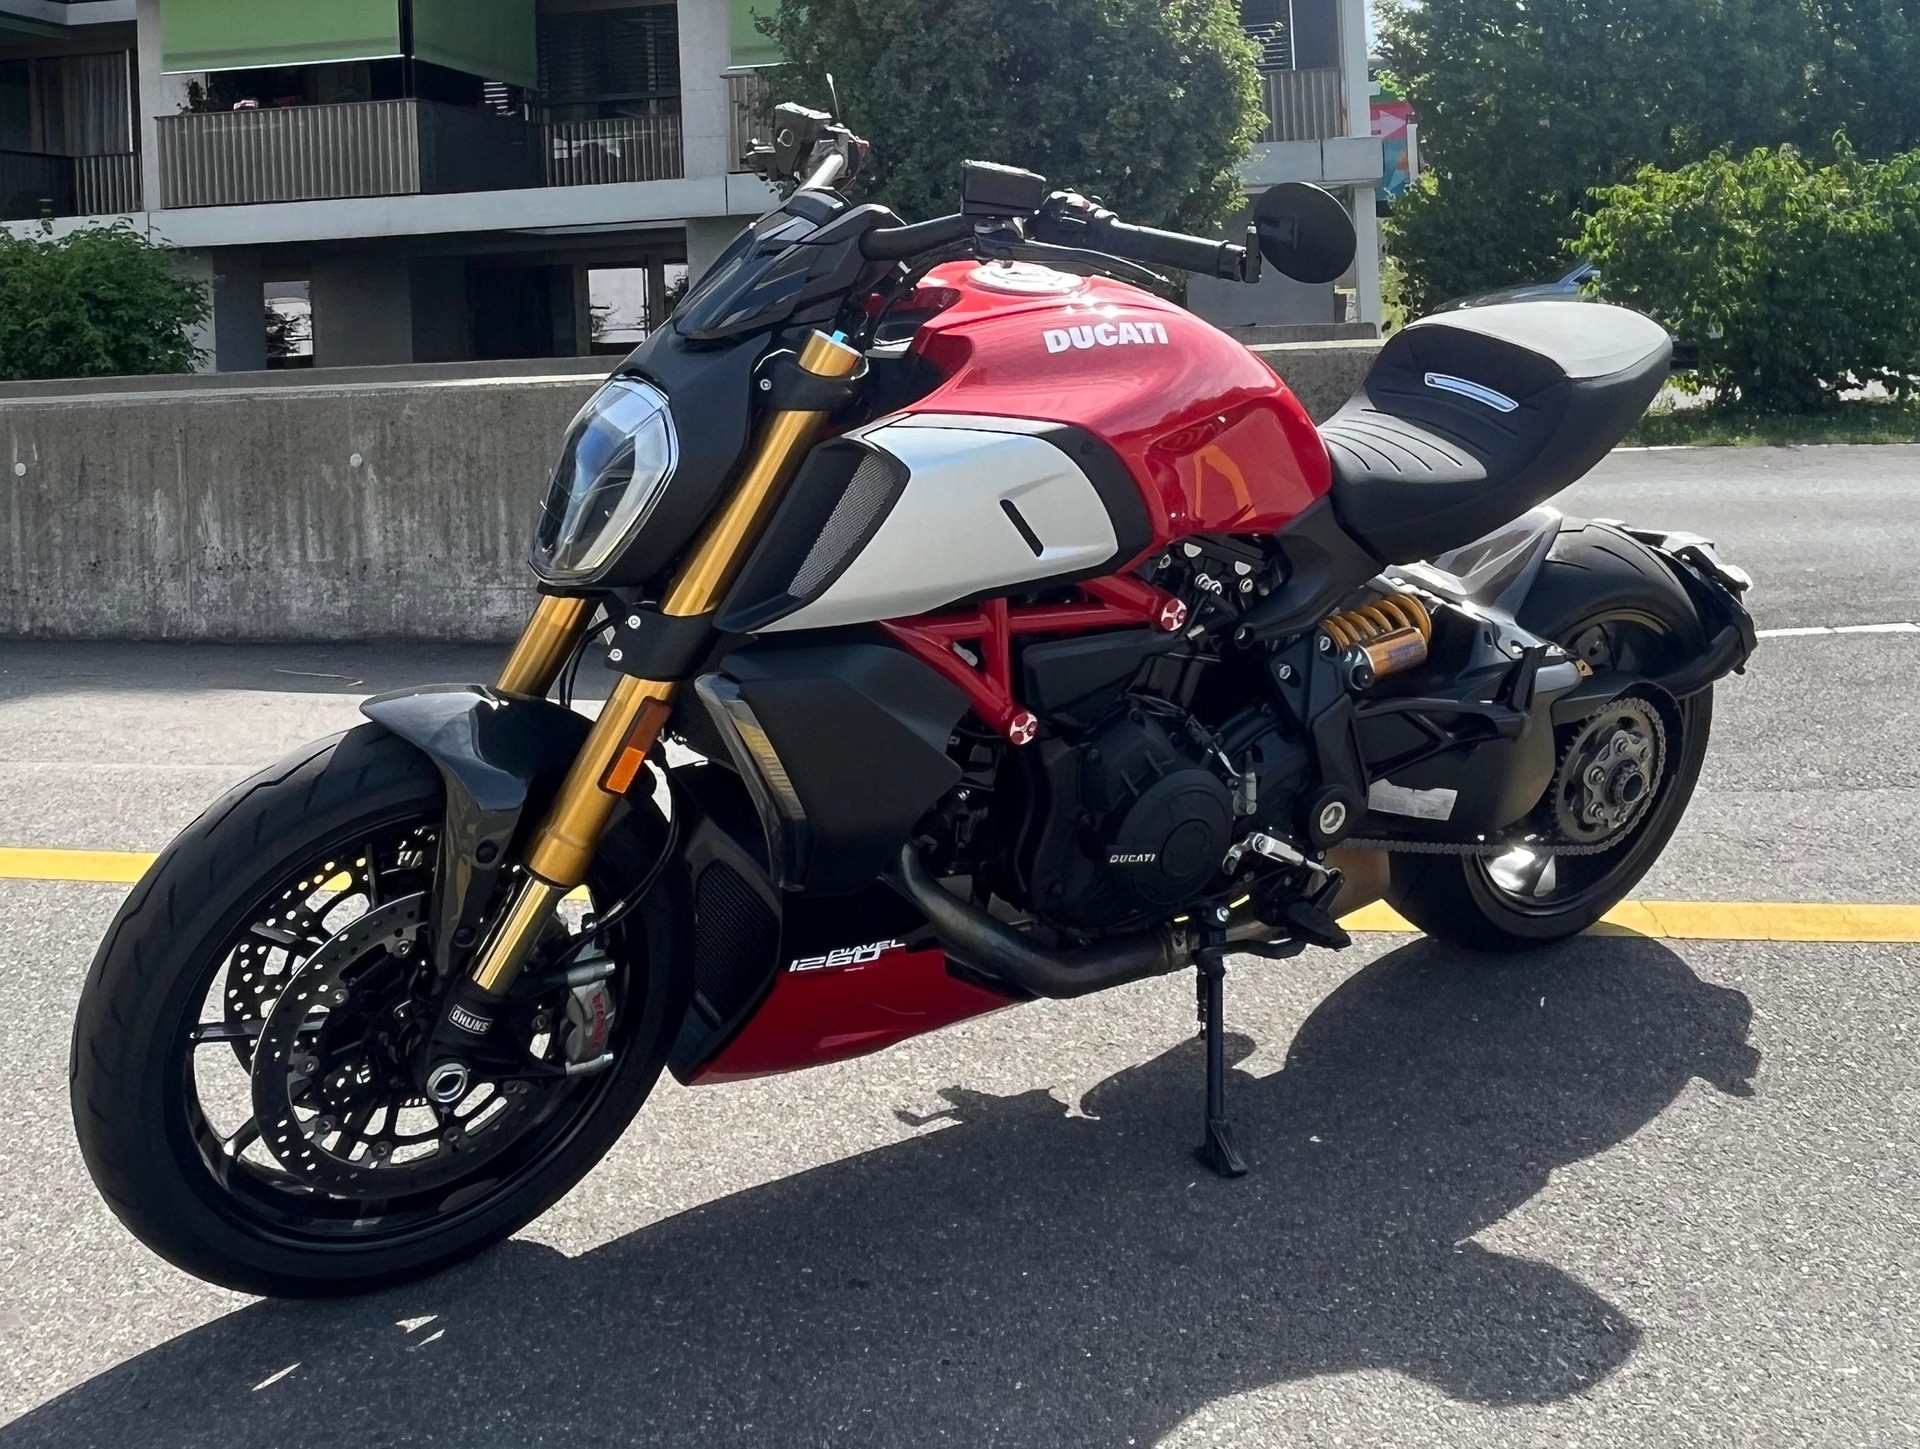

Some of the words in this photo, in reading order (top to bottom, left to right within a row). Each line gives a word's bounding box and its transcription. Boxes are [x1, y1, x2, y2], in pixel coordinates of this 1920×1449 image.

[1043, 322, 1169, 354] DUCATI
[1109, 853, 1156, 863] DUCATI
[789, 948, 881, 972] 1260
